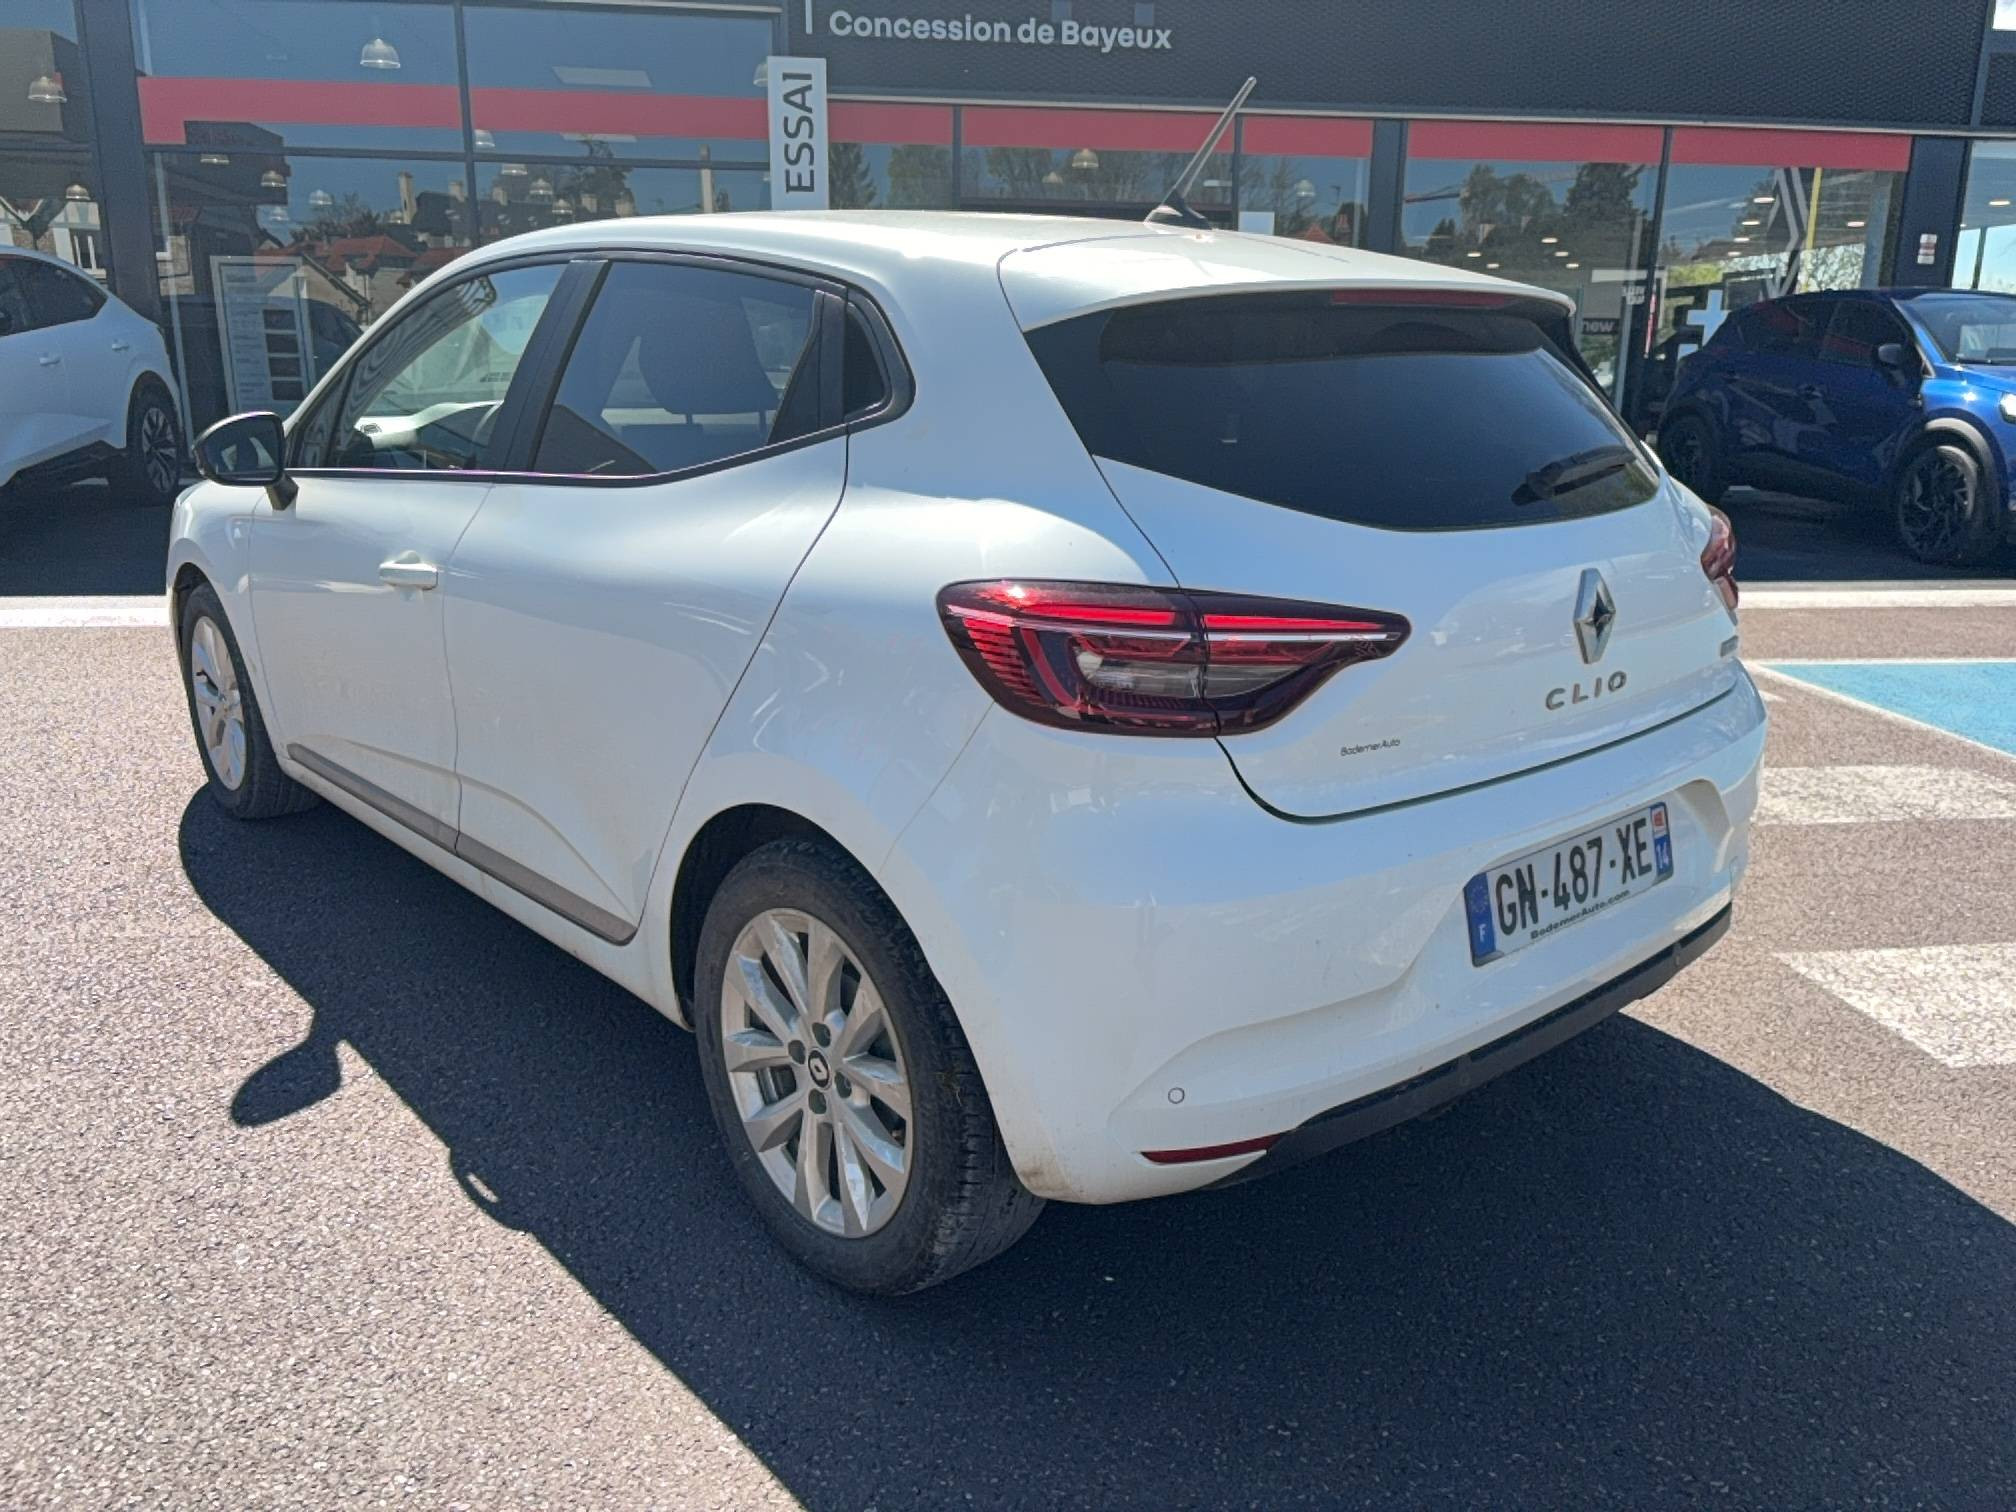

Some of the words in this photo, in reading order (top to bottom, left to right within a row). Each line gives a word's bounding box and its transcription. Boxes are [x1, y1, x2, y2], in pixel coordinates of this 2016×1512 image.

[829, 9, 1011, 43] Concession
[1017, 17, 1055, 45] de
[1061, 20, 1173, 53] Bayeux
[782, 72, 815, 194] ESSAI
[1545, 670, 1627, 710] CLIO
[1656, 837, 1671, 870] 14
[1495, 817, 1653, 936] GN-487-XE
[1478, 923, 1488, 943] F
[1530, 889, 1631, 940] BodemerAuto.com
